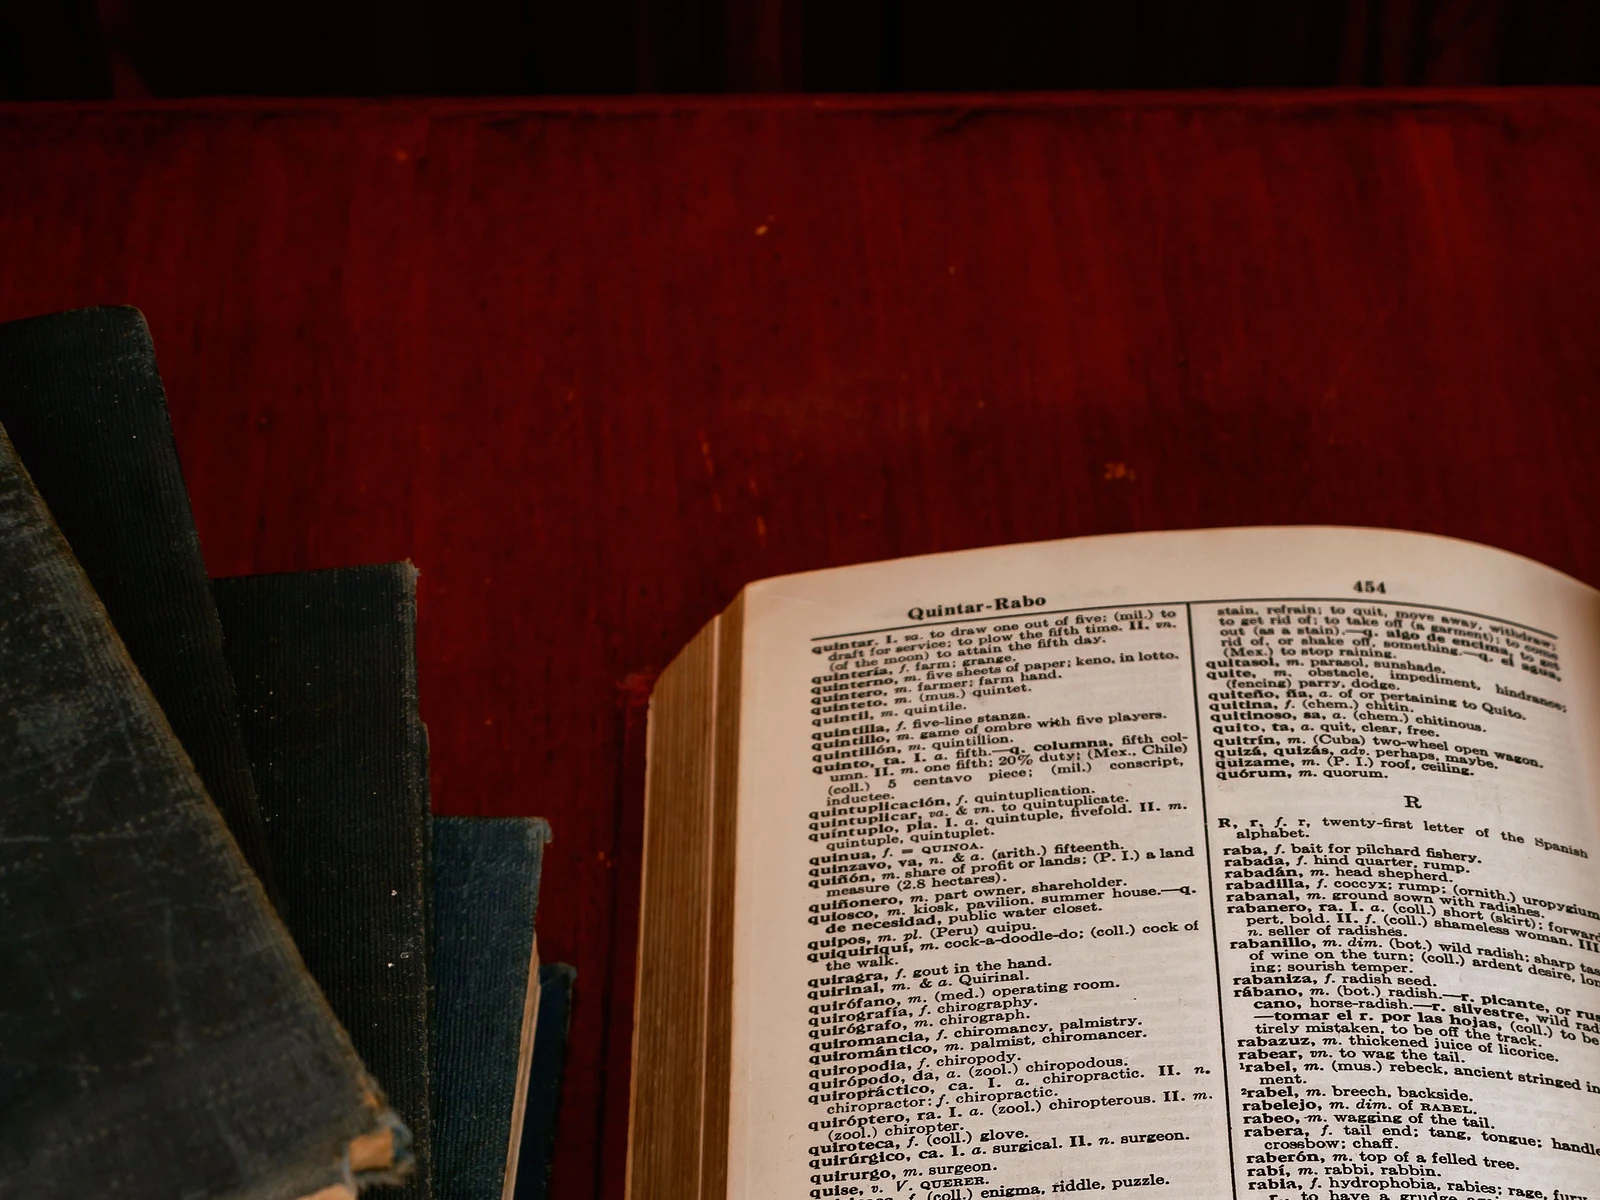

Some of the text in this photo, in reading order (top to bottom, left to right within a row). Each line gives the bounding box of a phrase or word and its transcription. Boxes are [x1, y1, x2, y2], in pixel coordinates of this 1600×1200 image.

[1353, 580, 1386, 595] 454
[908, 594, 1047, 621] Quintar-Rabo
[898, 663, 910, 674] f.
[915, 660, 956, 672] farm;
[961, 656, 1017, 670] grange.
[1286, 658, 1305, 667] m.
[1373, 660, 1446, 674] sunshade.
[1225, 677, 1292, 691] (fencing)
[1350, 678, 1400, 691] dodge.
[894, 696, 912, 705] m.
[919, 688, 966, 703] (mus.)
[971, 683, 1032, 699] quintet.
[811, 734, 1014, 764] quintillón, m. quintillion.
[1215, 768, 1389, 781] quórum, m. quorum.
[826, 792, 895, 807] inductee.
[928, 810, 949, 819] va.
[955, 806, 968, 816] &
[973, 806, 995, 815] vn.
[1000, 802, 1017, 813] to
[1022, 793, 1129, 813] quintuplicate.
[1403, 795, 1422, 809] R
[1236, 827, 1310, 841] alphabet.
[1224, 855, 1290, 869] rabada,
[1296, 854, 1308, 867] f.
[1313, 854, 1350, 866] hind
[1423, 861, 1470, 875] rump.
[1224, 866, 1454, 883] rabadán, m. head shepherd.
[807, 921, 1037, 952] quipos, m. pl. (Peru) quipu.
[825, 955, 899, 971] the walk.
[1287, 960, 1346, 973] sourish
[1350, 961, 1414, 976] temper.
[1232, 972, 1437, 987] rabaniza, f. radish seed.
[808, 980, 1120, 1016] quirófano, m. (med.) operating room.
[808, 1030, 930, 1054] quiromancia,
[935, 1028, 948, 1042] f.
[1059, 1016, 1143, 1034] palmistry.
[1237, 1047, 1466, 1064] rabear, vn. to wag the tail.
[1259, 1073, 1307, 1086] ment.
[1241, 1099, 1478, 1115] rabelejo, m. dim. of RABEL.
[1242, 1112, 1496, 1130] rabeo, m. wagging of the tail.
[827, 1121, 965, 1145] (zool.) chiropter.
[809, 1162, 998, 1186] quirurgo, m. surgeon.
[1246, 1164, 1291, 1180] rabí,
[1297, 1166, 1319, 1176] m.
[1379, 1164, 1442, 1178] rabbin.
